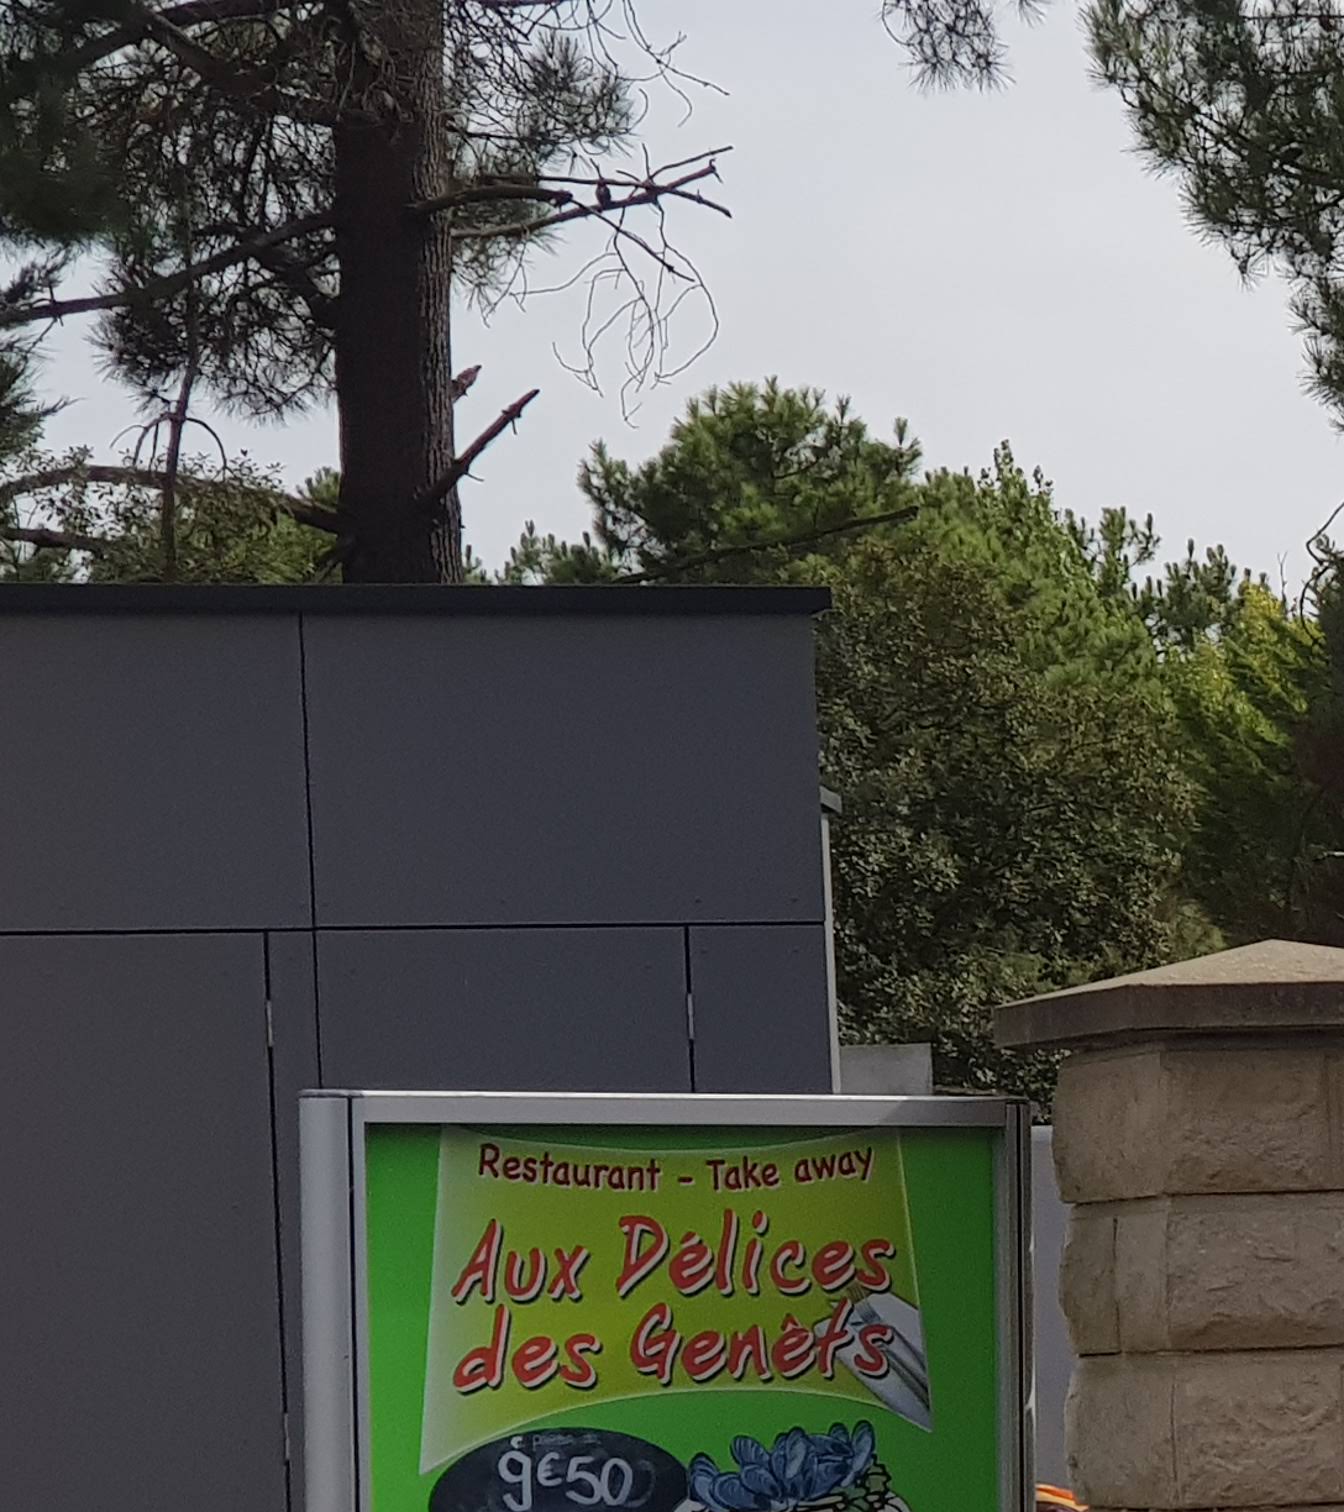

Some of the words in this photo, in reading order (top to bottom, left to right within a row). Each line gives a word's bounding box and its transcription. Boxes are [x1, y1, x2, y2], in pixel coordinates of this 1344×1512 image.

[479, 1144, 660, 1190] Restaurant
[709, 1157, 779, 1191] Take
[795, 1146, 873, 1182] away
[452, 1218, 589, 1302] Aux
[616, 1209, 896, 1297] Délices
[454, 1305, 602, 1392] des
[631, 1300, 896, 1384] Genêts
